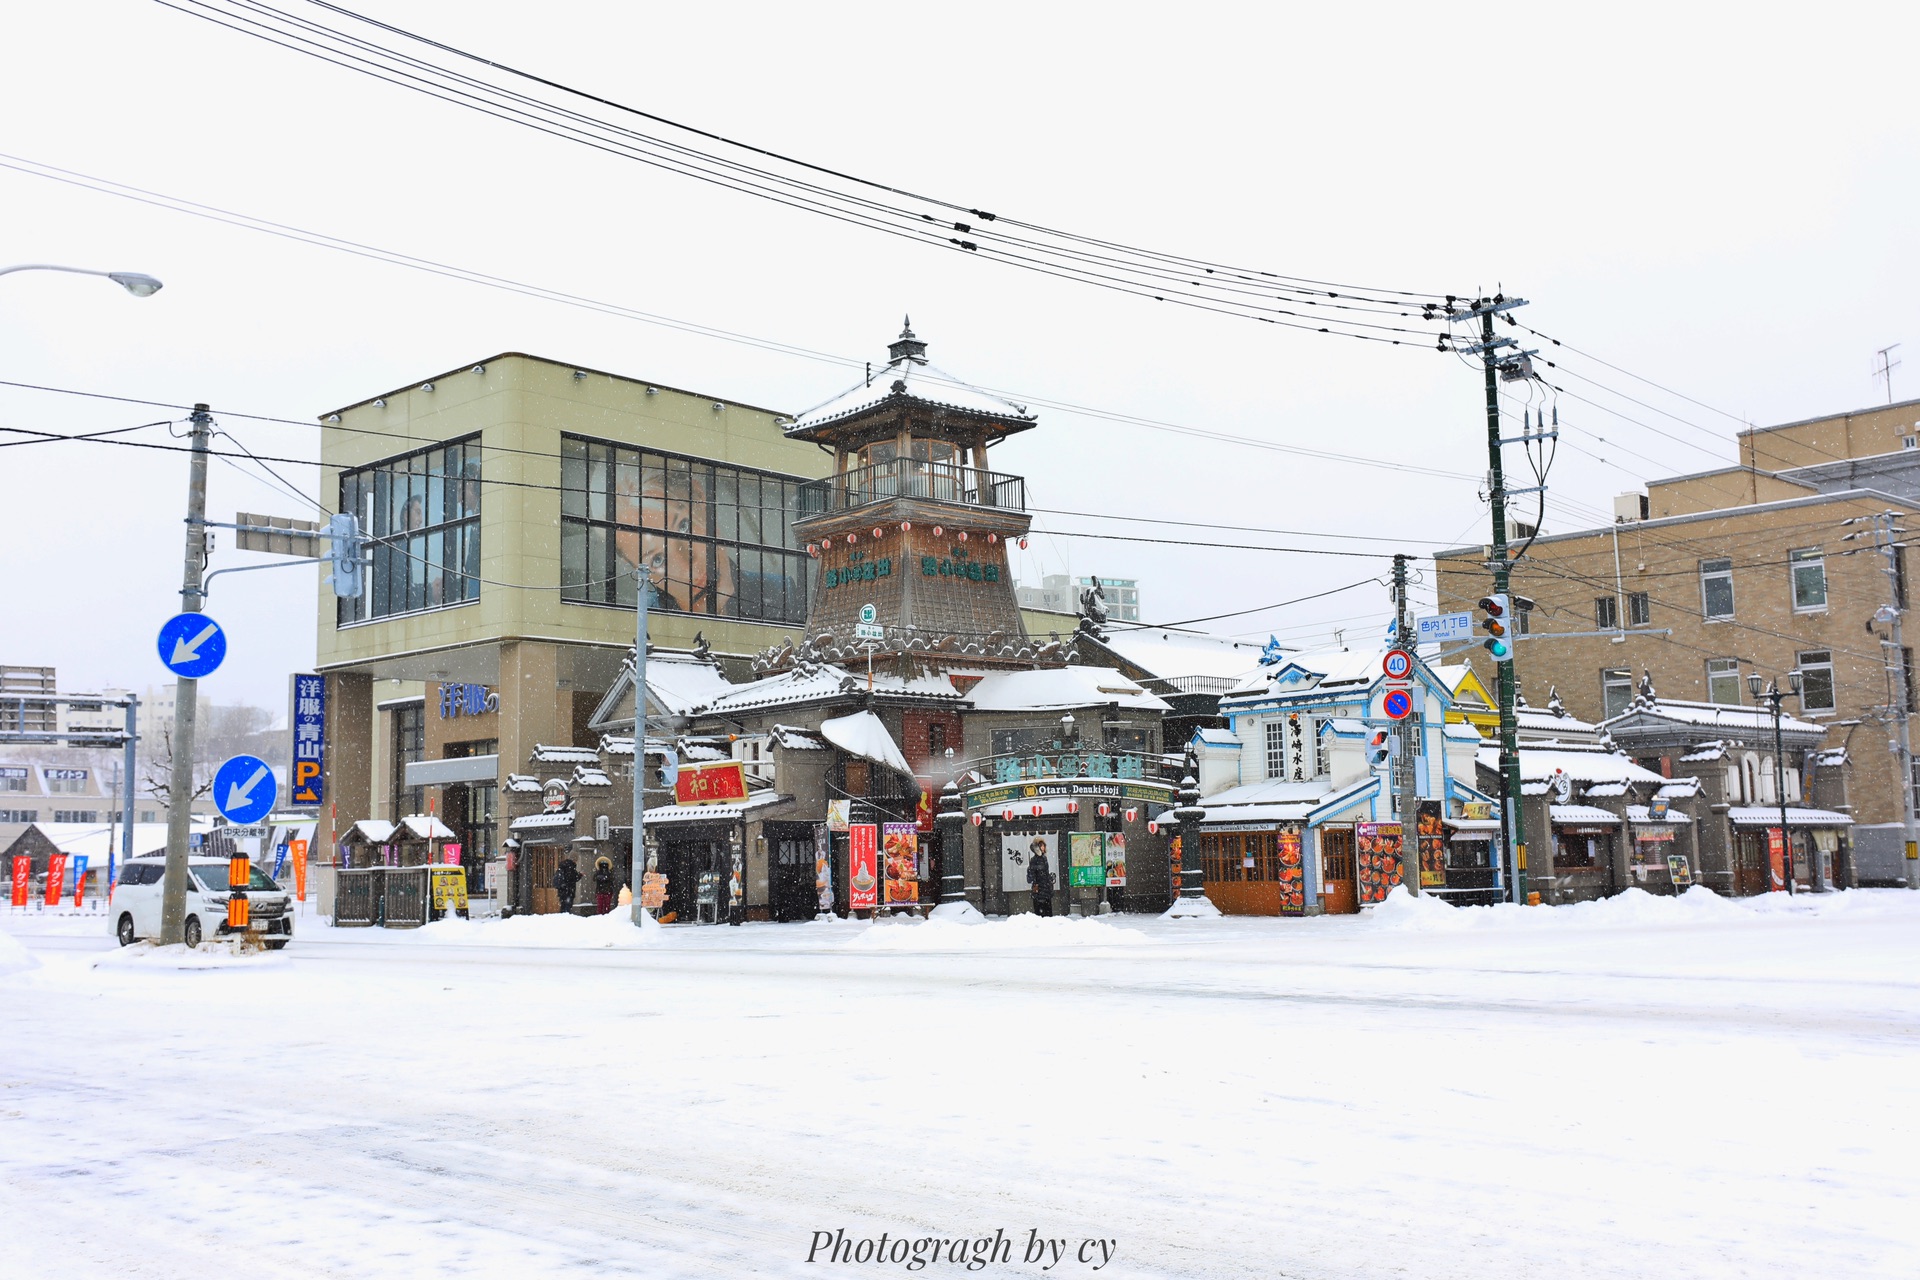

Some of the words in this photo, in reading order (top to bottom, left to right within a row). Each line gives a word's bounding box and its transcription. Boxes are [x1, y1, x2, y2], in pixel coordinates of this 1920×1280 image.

[1421, 616, 1468, 632] 色内1丁目
[1389, 657, 1405, 671] 40
[298, 679, 322, 758] 洋服の青山
[296, 761, 320, 787] P
[1039, 785, 1067, 795] Otaru
[1072, 784, 1119, 796] Denuki-koji
[223, 828, 266, 837] 中央分離帯
